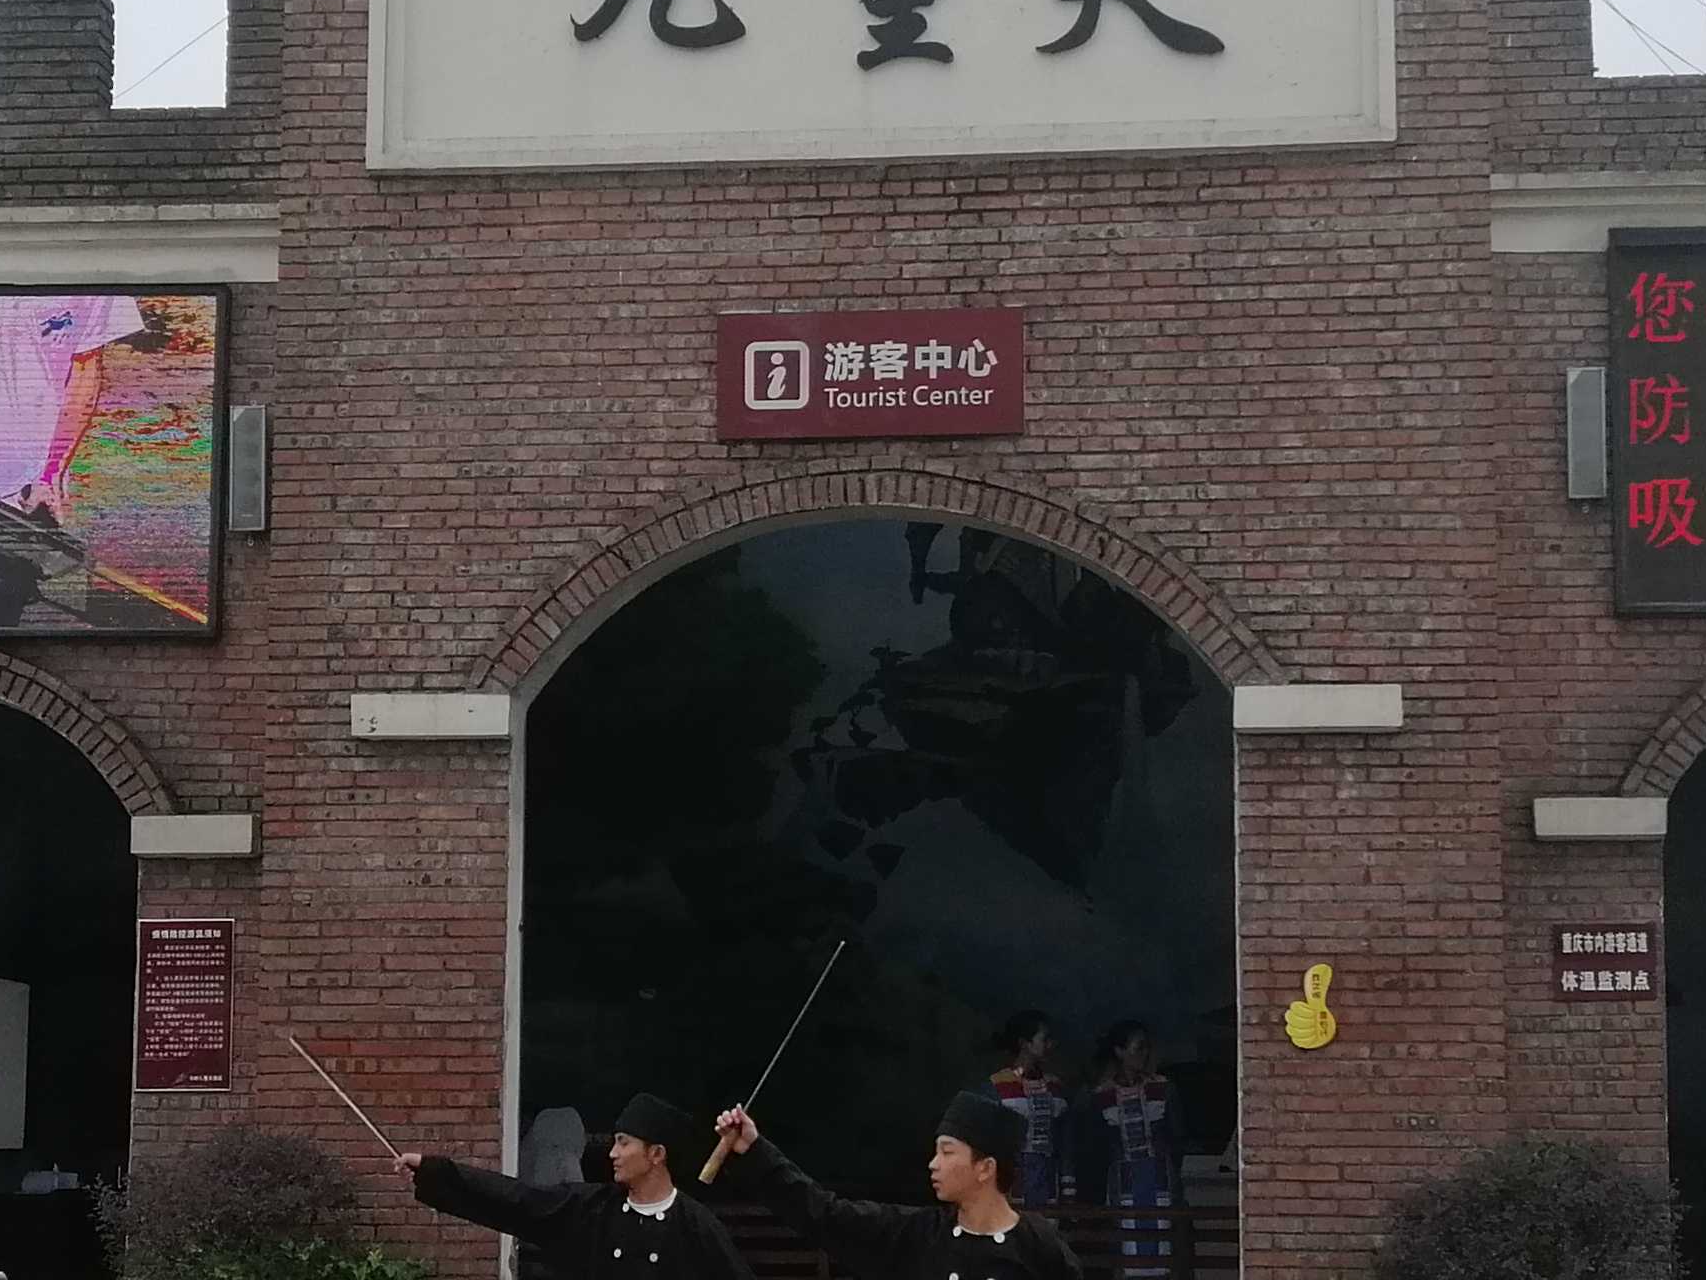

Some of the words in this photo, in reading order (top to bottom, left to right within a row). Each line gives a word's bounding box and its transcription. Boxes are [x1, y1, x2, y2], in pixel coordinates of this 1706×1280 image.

[823, 338, 999, 382] 游客中心
[823, 386, 906, 409] Tourist
[912, 384, 994, 407] Center
[1561, 931, 1649, 953] 重庆市内游客通道
[1561, 969, 1651, 992] 体温监测点
